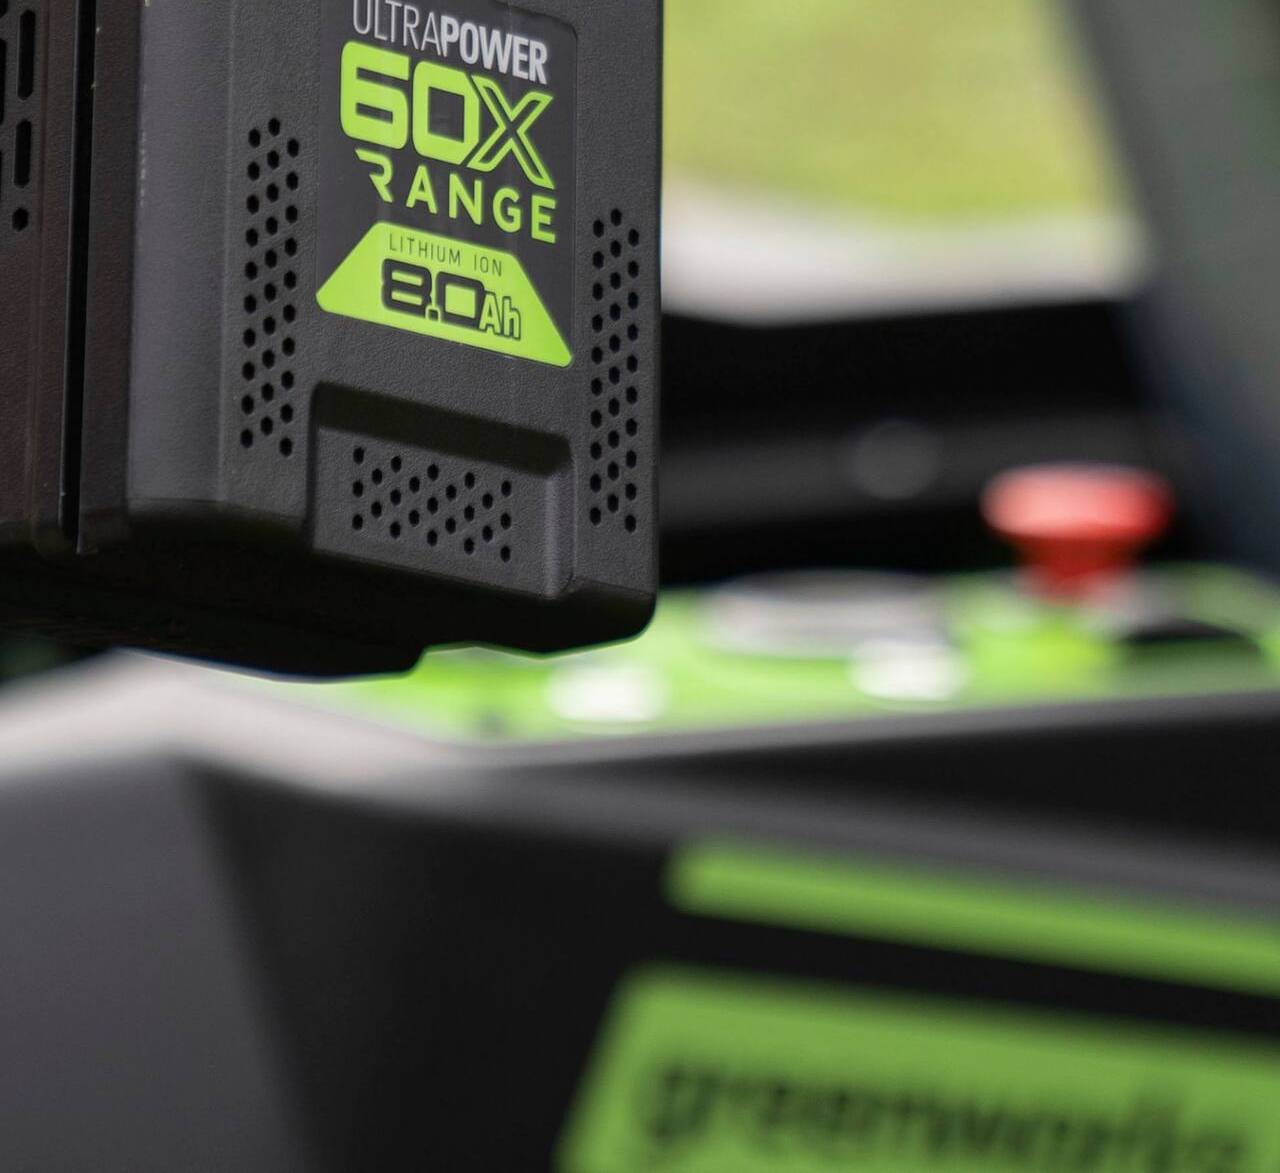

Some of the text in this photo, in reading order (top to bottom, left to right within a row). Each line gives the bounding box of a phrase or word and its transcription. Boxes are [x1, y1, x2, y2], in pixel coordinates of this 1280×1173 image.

[340, 40, 556, 190] 60X
[354, 148, 557, 244] RANGE
[388, 231, 503, 277] LITHIUM ION
